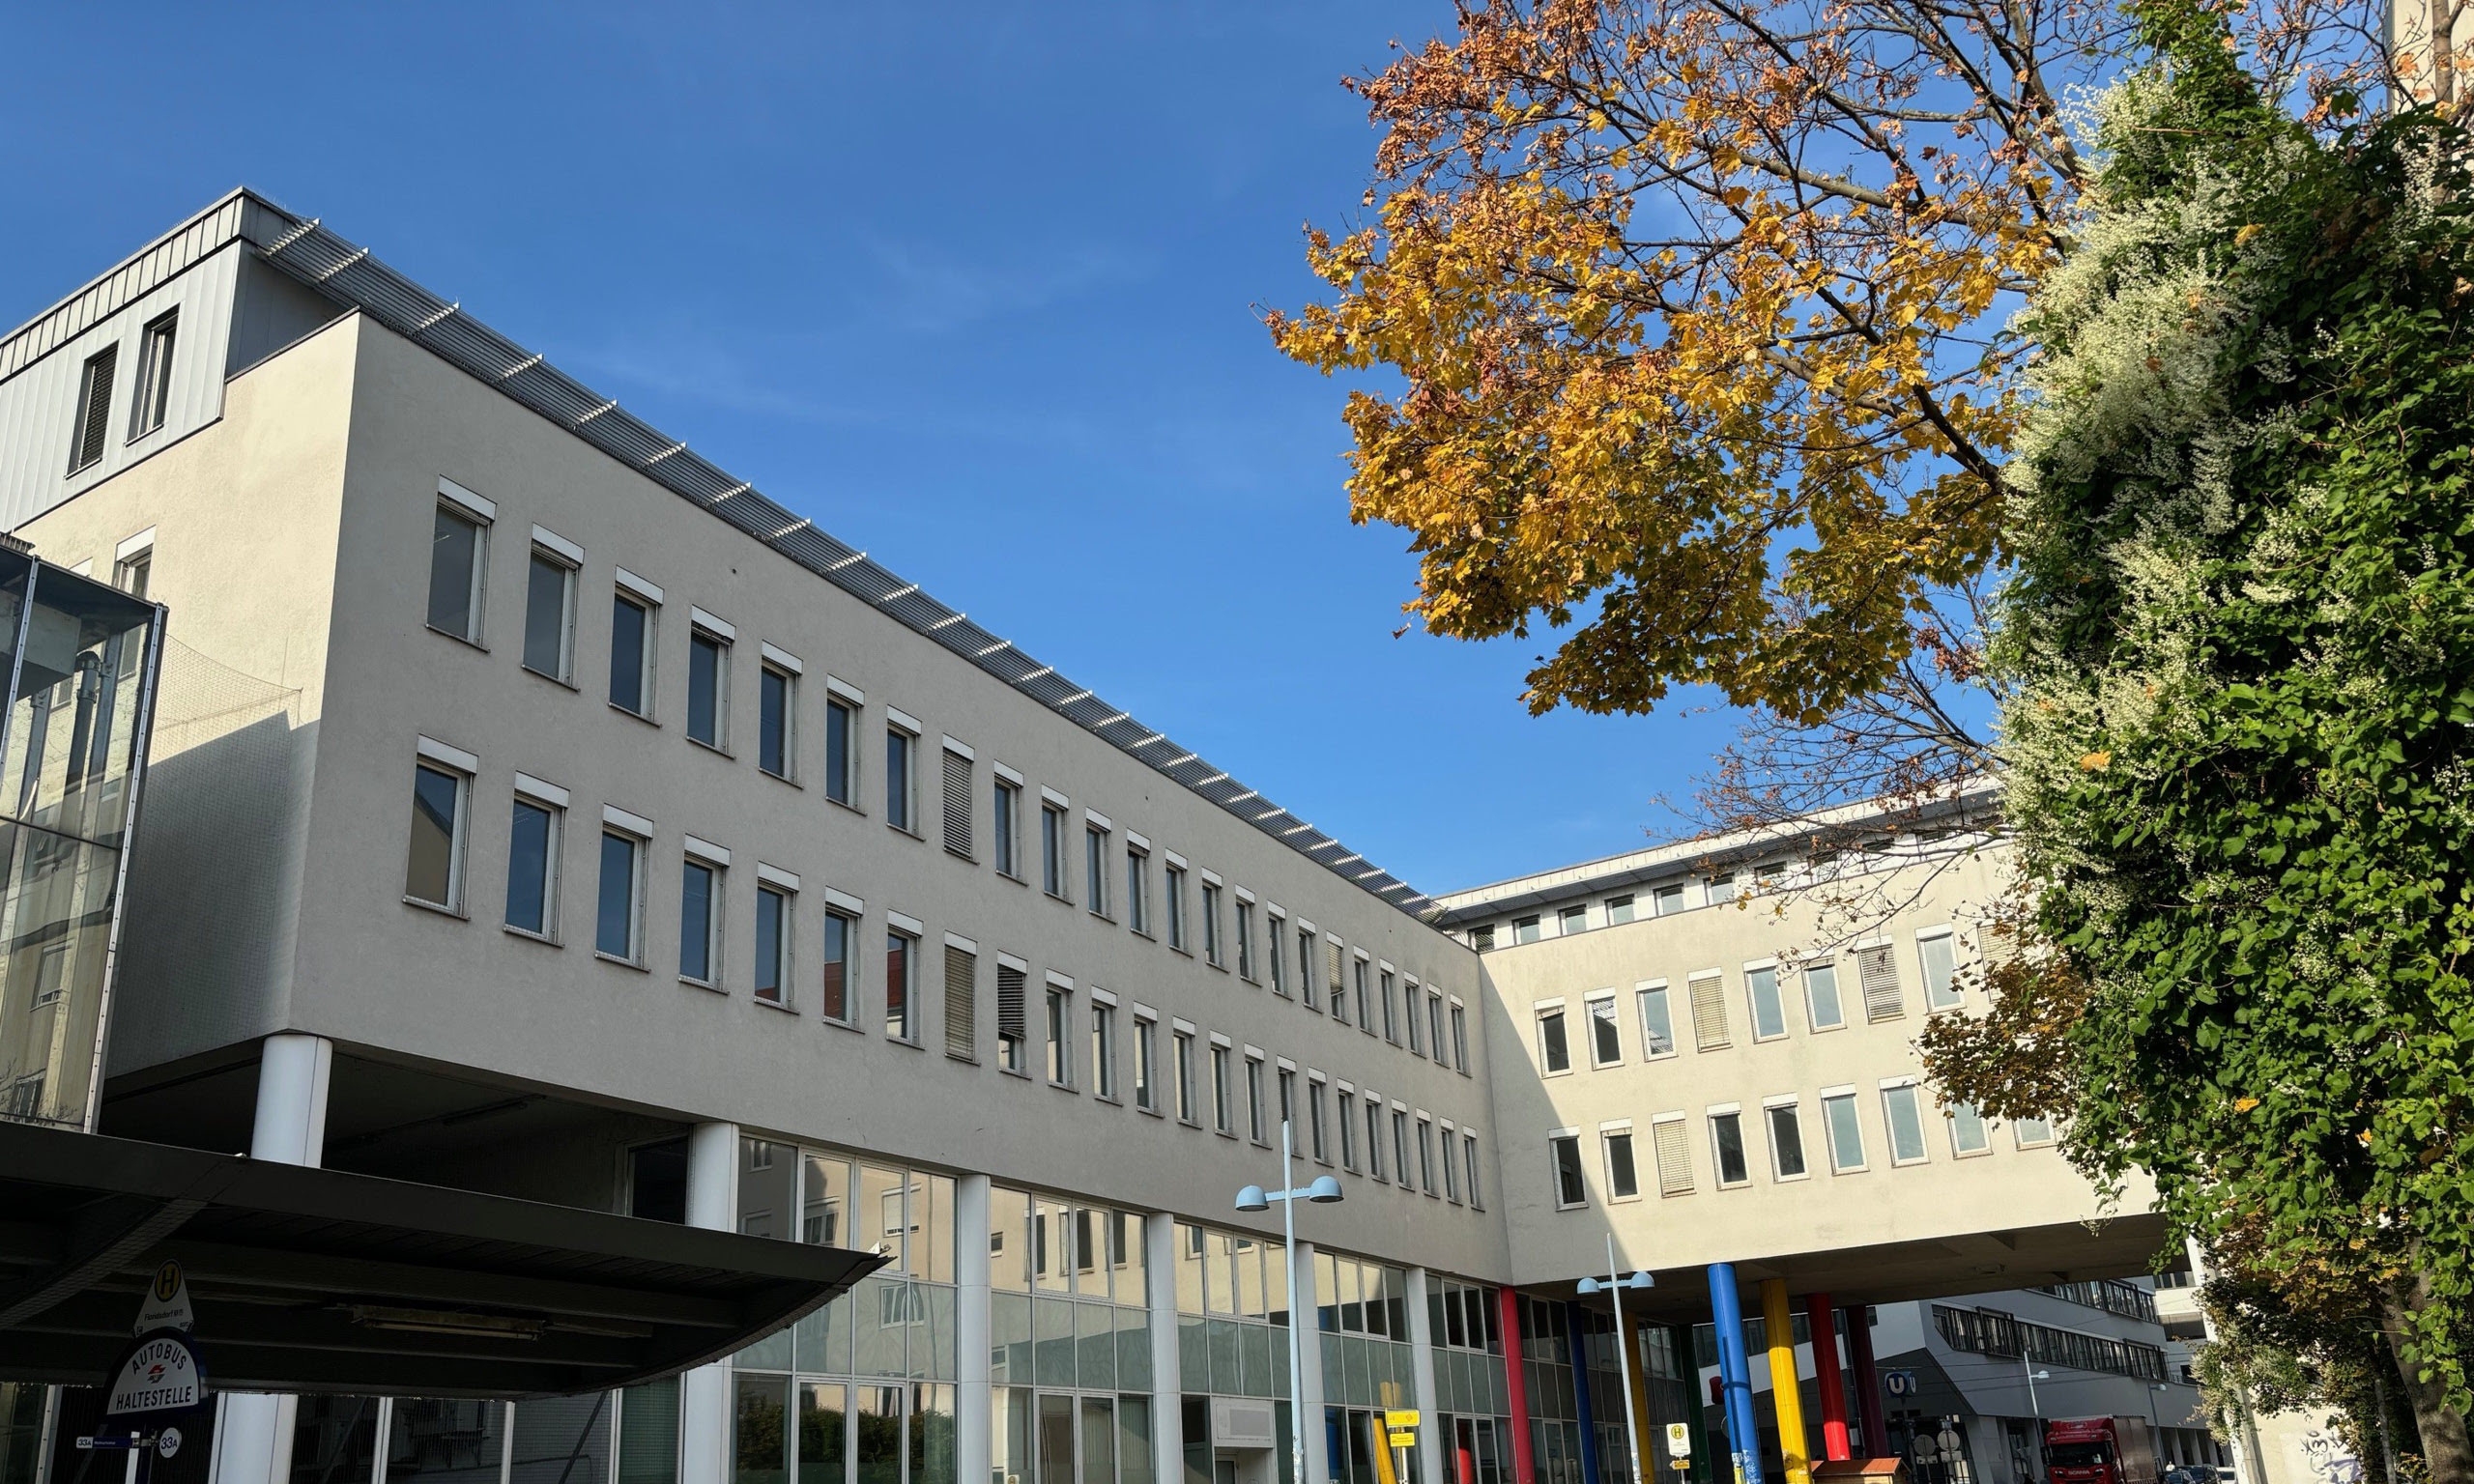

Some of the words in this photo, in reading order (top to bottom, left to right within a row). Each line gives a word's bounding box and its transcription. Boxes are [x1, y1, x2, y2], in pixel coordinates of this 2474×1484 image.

[160, 1267, 176, 1295] H
[131, 1342, 187, 1375] AUTOBUS
[1888, 1377, 1905, 1394] U
[1909, 1376, 1916, 1393] U
[116, 1385, 192, 1410] HALTESTELLE
[1674, 1428, 1682, 1438] H
[160, 1437, 178, 1449] 33A
